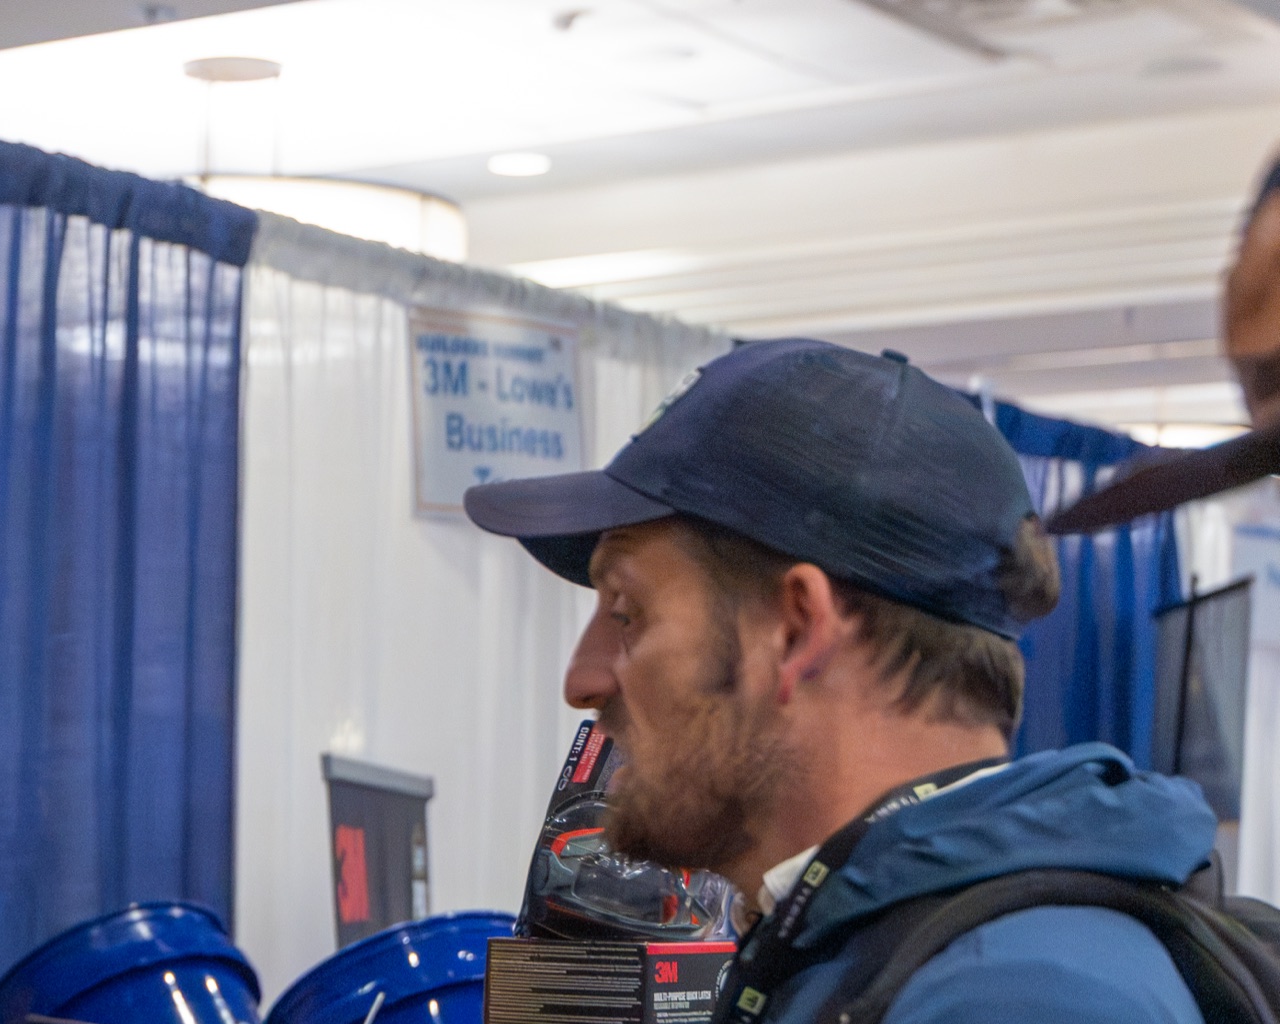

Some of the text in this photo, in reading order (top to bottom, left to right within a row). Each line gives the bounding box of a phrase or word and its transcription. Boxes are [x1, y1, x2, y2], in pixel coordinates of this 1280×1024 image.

[424, 356, 468, 397] 3M
[445, 412, 564, 460] Business
[654, 961, 678, 983] 3M
